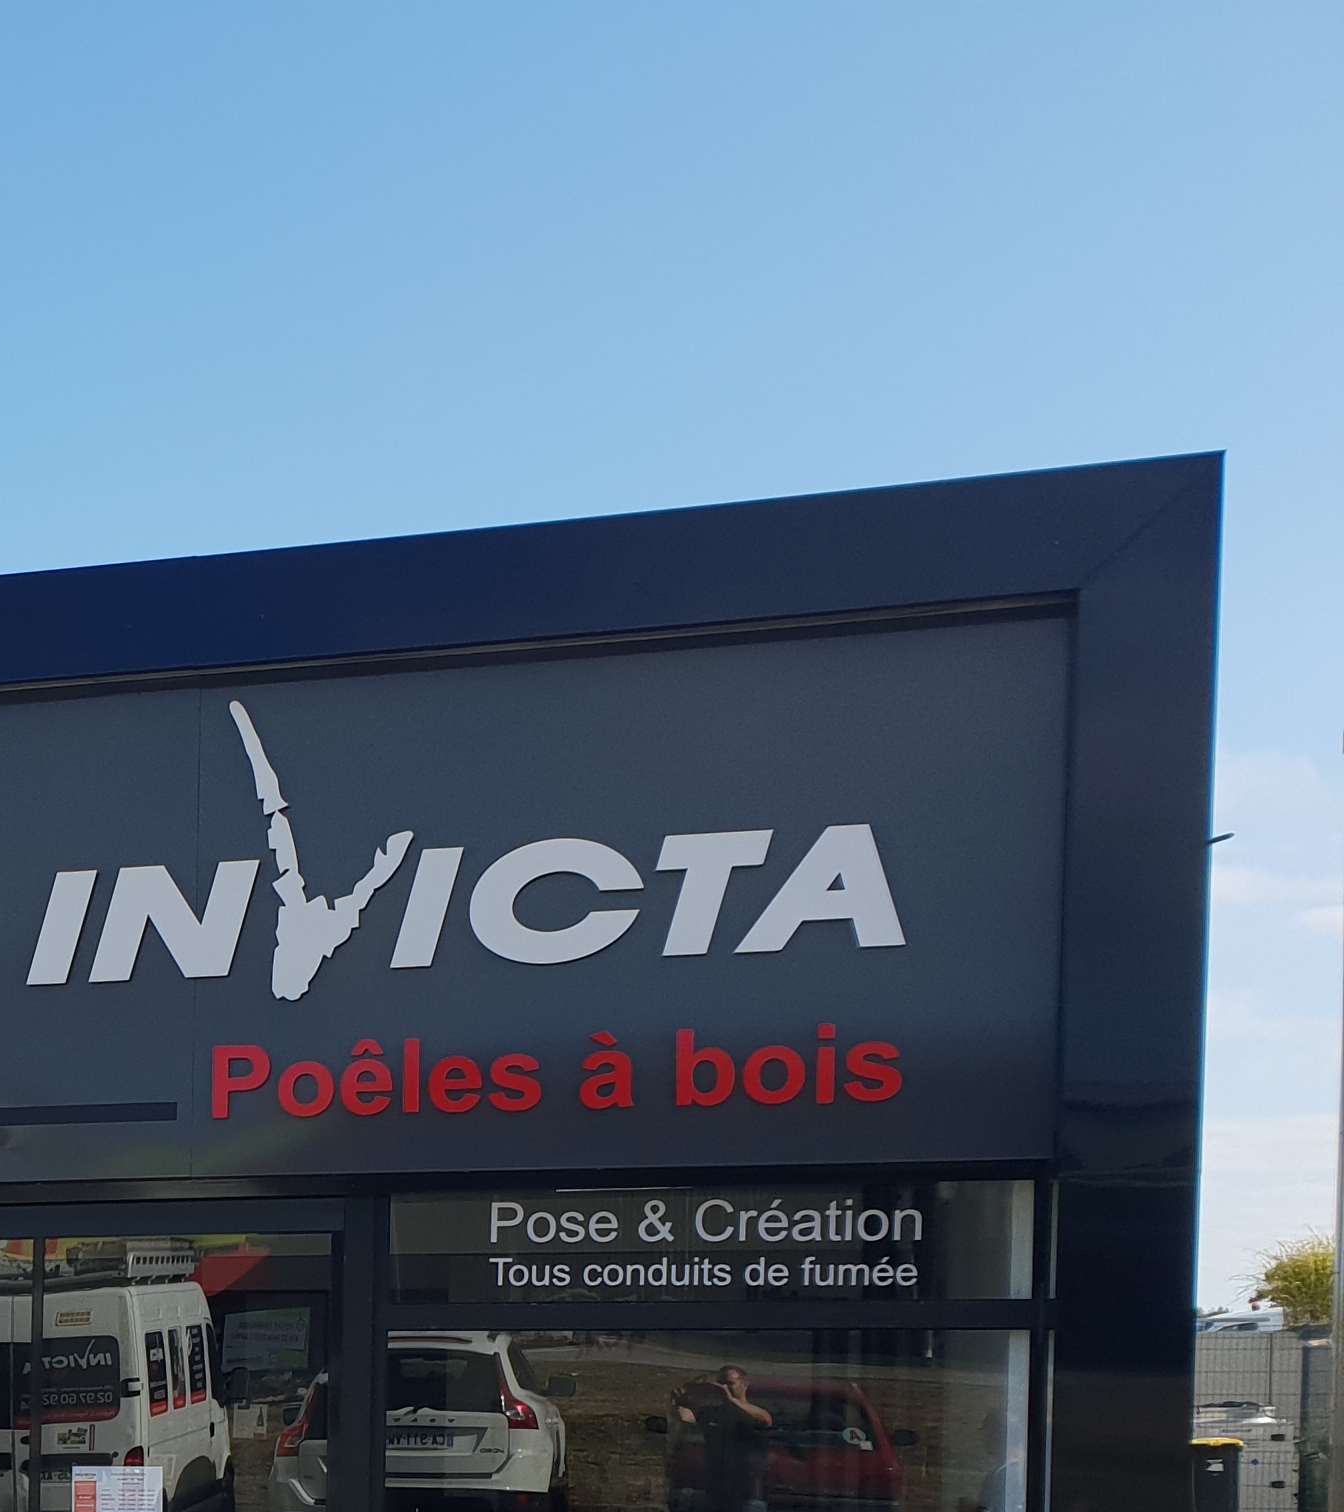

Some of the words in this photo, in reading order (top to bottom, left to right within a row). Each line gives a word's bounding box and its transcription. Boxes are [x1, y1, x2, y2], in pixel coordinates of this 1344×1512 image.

[26, 700, 907, 1000] INVICTA
[210, 1037, 543, 1121] Poêles
[579, 1031, 634, 1110] à
[674, 1022, 903, 1108] bois
[490, 1201, 619, 1243] Pose
[637, 1199, 675, 1243] &
[695, 1198, 923, 1243] Création
[489, 1257, 571, 1287] Tous
[583, 1256, 732, 1287] conduits
[744, 1256, 789, 1287] de
[801, 1256, 919, 1287] fumée
